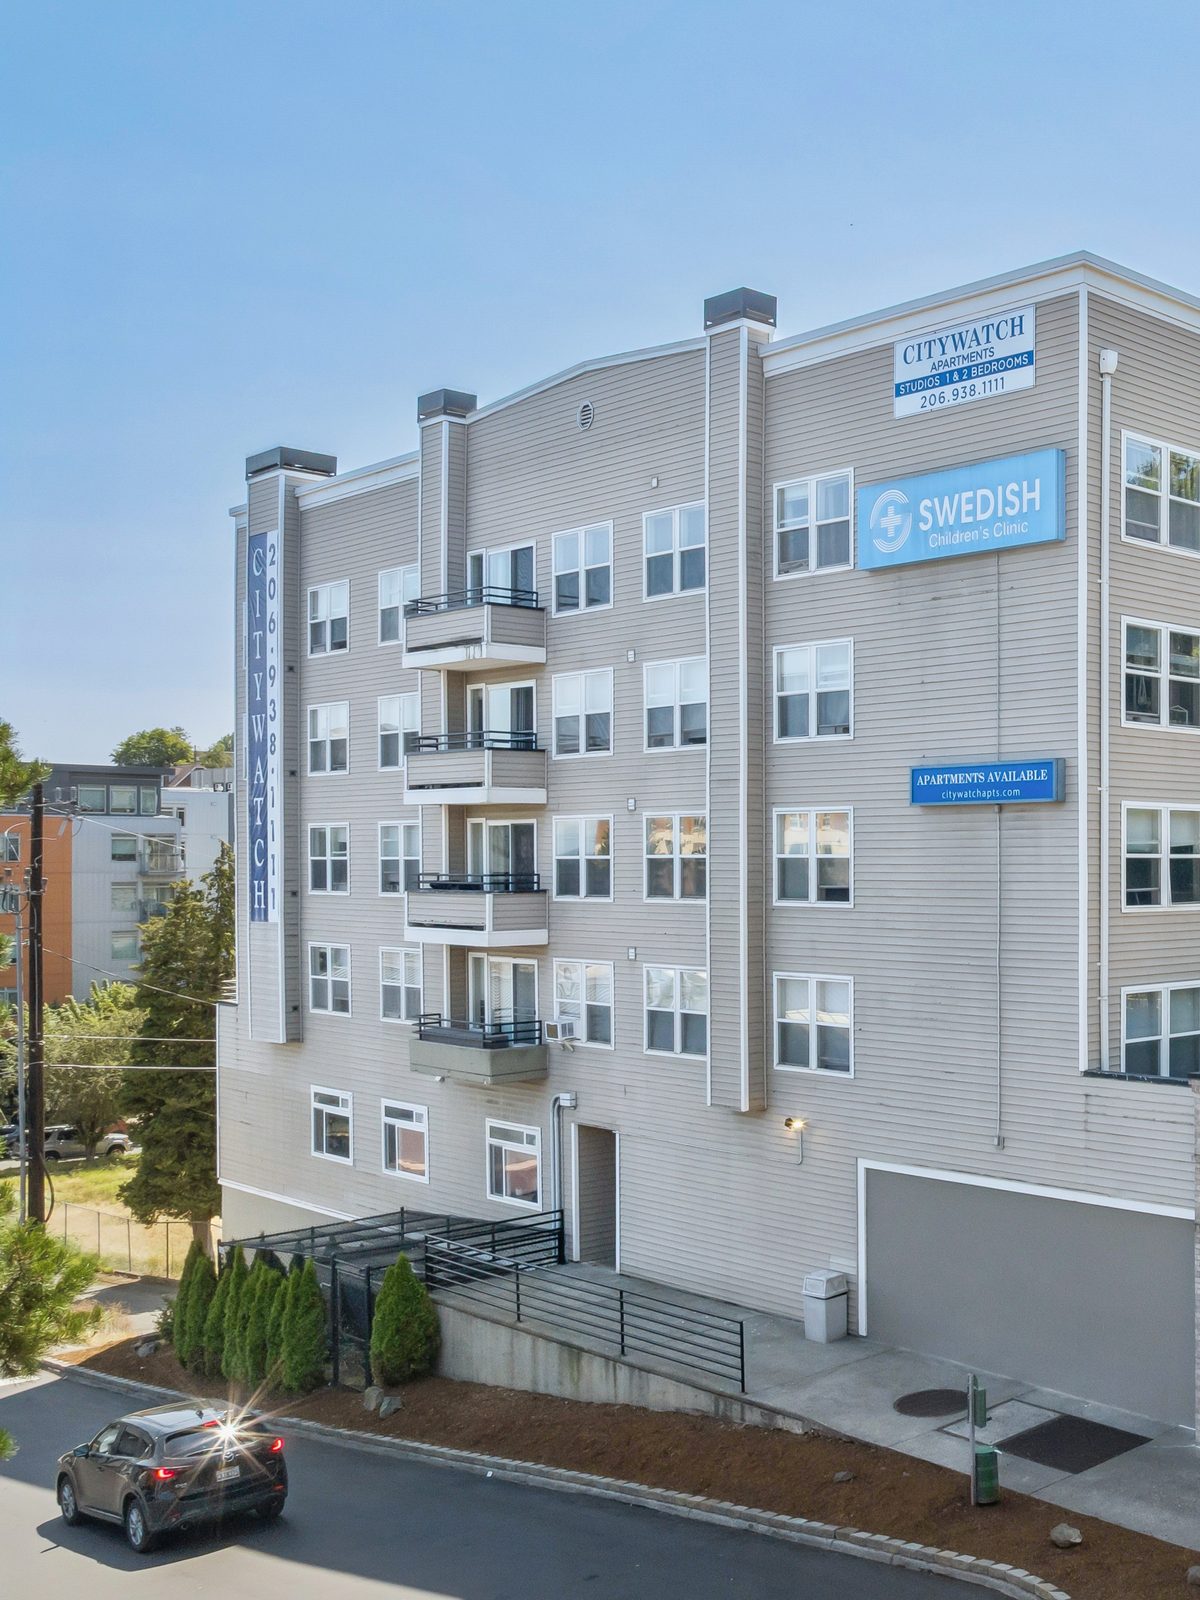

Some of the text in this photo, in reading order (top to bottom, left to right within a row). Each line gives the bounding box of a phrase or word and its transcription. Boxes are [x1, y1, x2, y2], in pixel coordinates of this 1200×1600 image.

[903, 314, 1025, 365] CITYWATCH
[900, 354, 1029, 394] STUDIOS 1 & 2 BEDROOMS
[930, 346, 995, 373] APARTMENTS
[920, 376, 1005, 409] 206.938.1111
[919, 478, 1041, 531] SWEDISH
[929, 519, 1028, 548] Children's Clinic
[252, 548, 266, 909] CITYWATCH
[917, 769, 1048, 786] APARTMENTS AVAILABLE
[941, 788, 1021, 801] citywatchapts.com
